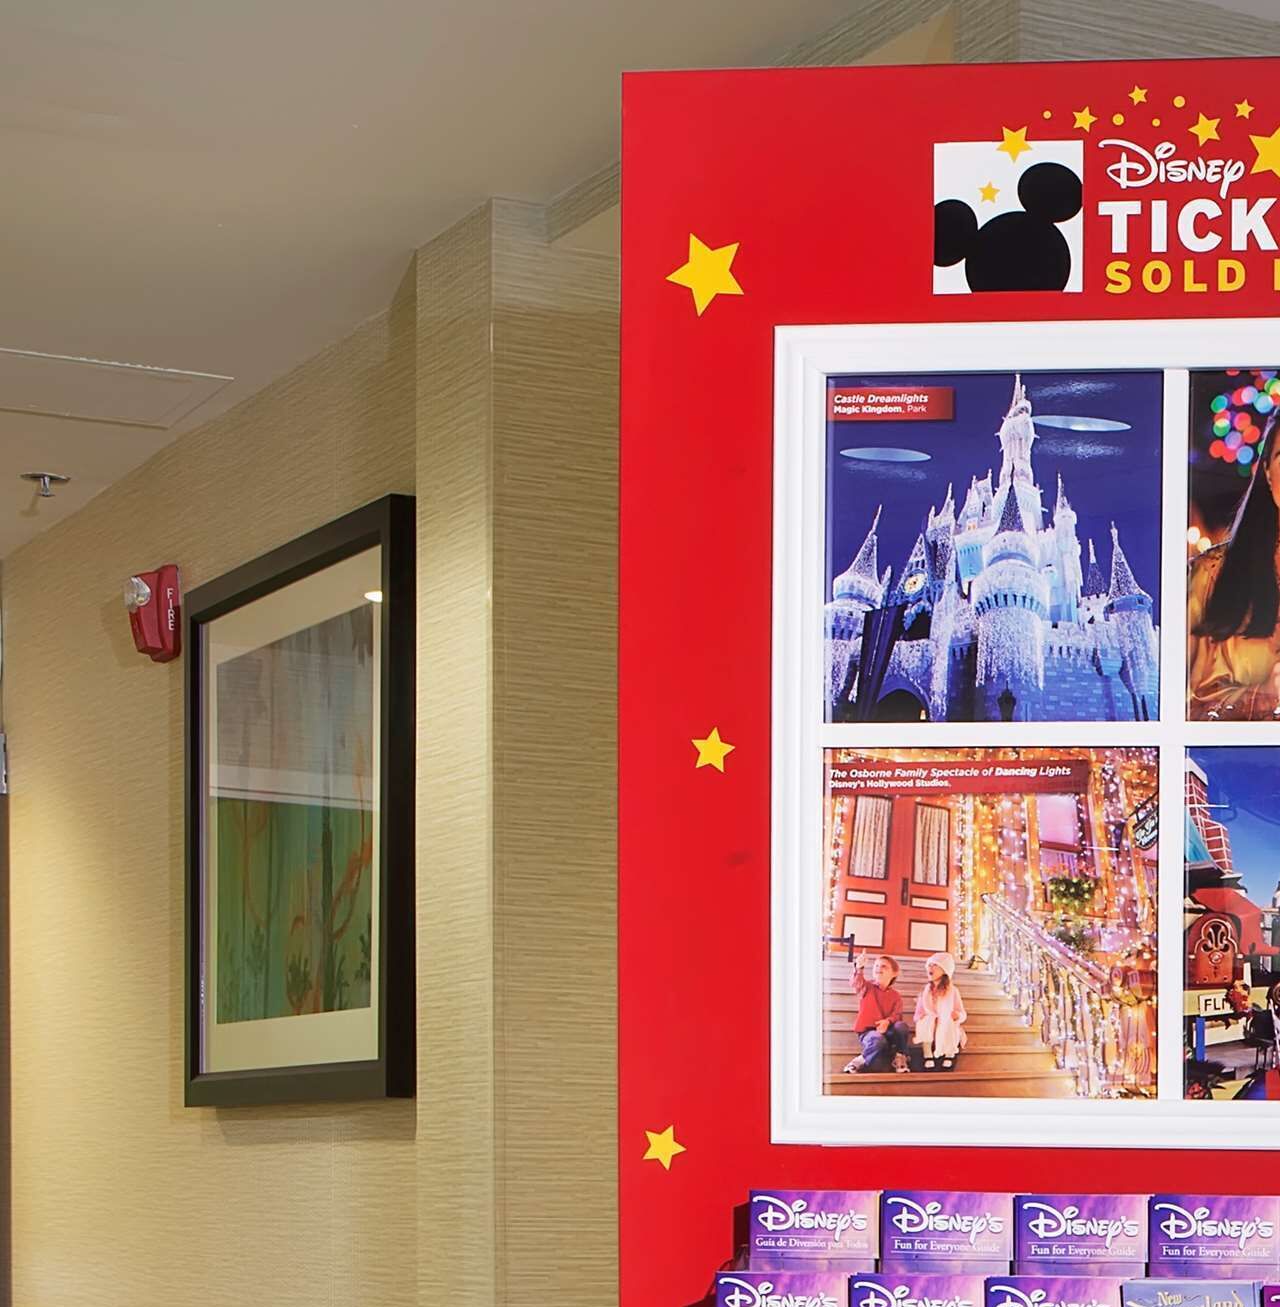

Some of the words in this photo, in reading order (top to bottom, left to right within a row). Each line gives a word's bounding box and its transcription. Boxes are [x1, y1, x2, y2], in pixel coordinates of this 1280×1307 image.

[1098, 139, 1245, 198] Disney
[1104, 260, 1246, 294] SOLD
[834, 394, 865, 404] Castle
[868, 394, 929, 404] Dreamlights
[833, 405, 860, 415] Magic
[907, 405, 927, 413] Park
[167, 588, 175, 630] FIRE
[830, 769, 847, 778] The
[849, 769, 892, 778] Osborne
[894, 769, 928, 778] Family
[930, 768, 979, 778] Spectacle
[981, 767, 994, 776] of
[995, 767, 1037, 777] Dancing
[1039, 766, 1071, 777] Lights
[829, 780, 865, 789] Disney's
[867, 779, 913, 788] Hollywood
[753, 1195, 867, 1241] Disney's
[887, 1197, 1003, 1245] Disney's
[1023, 1202, 1139, 1249] Disney's
[1154, 1203, 1274, 1249] Disney's
[777, 1238, 787, 1247] de
[894, 1240, 912, 1249] Fun
[914, 1240, 928, 1250] for
[930, 1241, 971, 1253] Everyone
[1031, 1245, 1049, 1255] Fun
[1052, 1245, 1066, 1255] for
[1069, 1245, 1108, 1257] Everyone
[1109, 1247, 1136, 1256] Guide
[1162, 1246, 1180, 1256] Fun
[1183, 1246, 1196, 1256] for
[1199, 1247, 1240, 1259] Everyone
[1242, 1247, 1270, 1257] Guide
[1157, 1291, 1183, 1306] New
